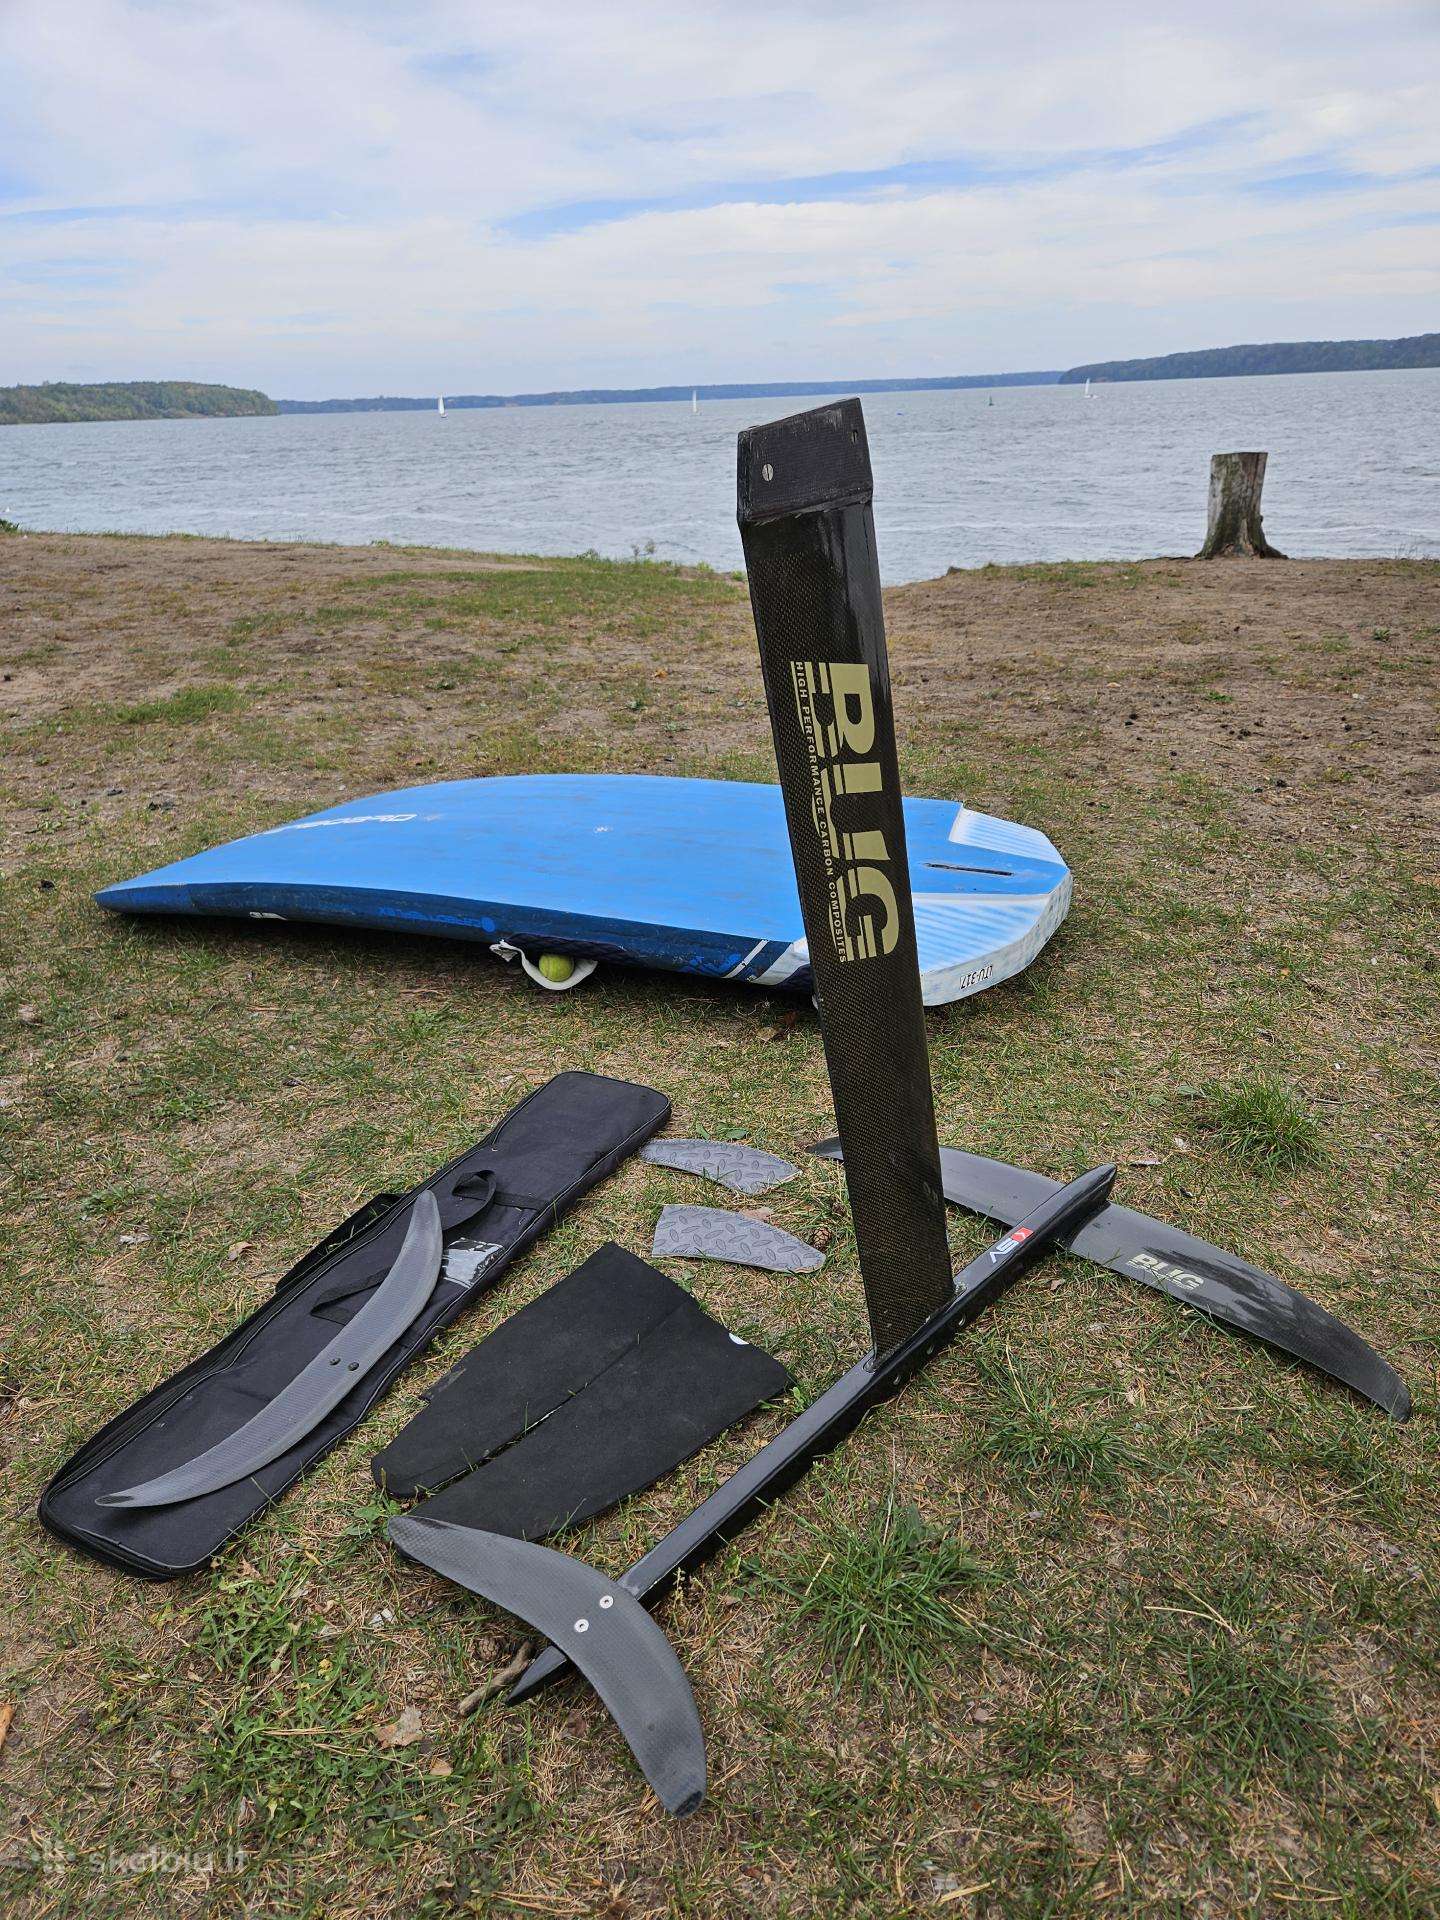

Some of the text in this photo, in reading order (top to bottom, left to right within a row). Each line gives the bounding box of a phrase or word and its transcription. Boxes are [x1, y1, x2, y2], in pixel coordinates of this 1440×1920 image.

[790, 661, 899, 962] BUG
[794, 661, 848, 963] HIGH PERFORMANCE CARBON COMPOSITES
[1125, 1253, 1205, 1290] BUG
